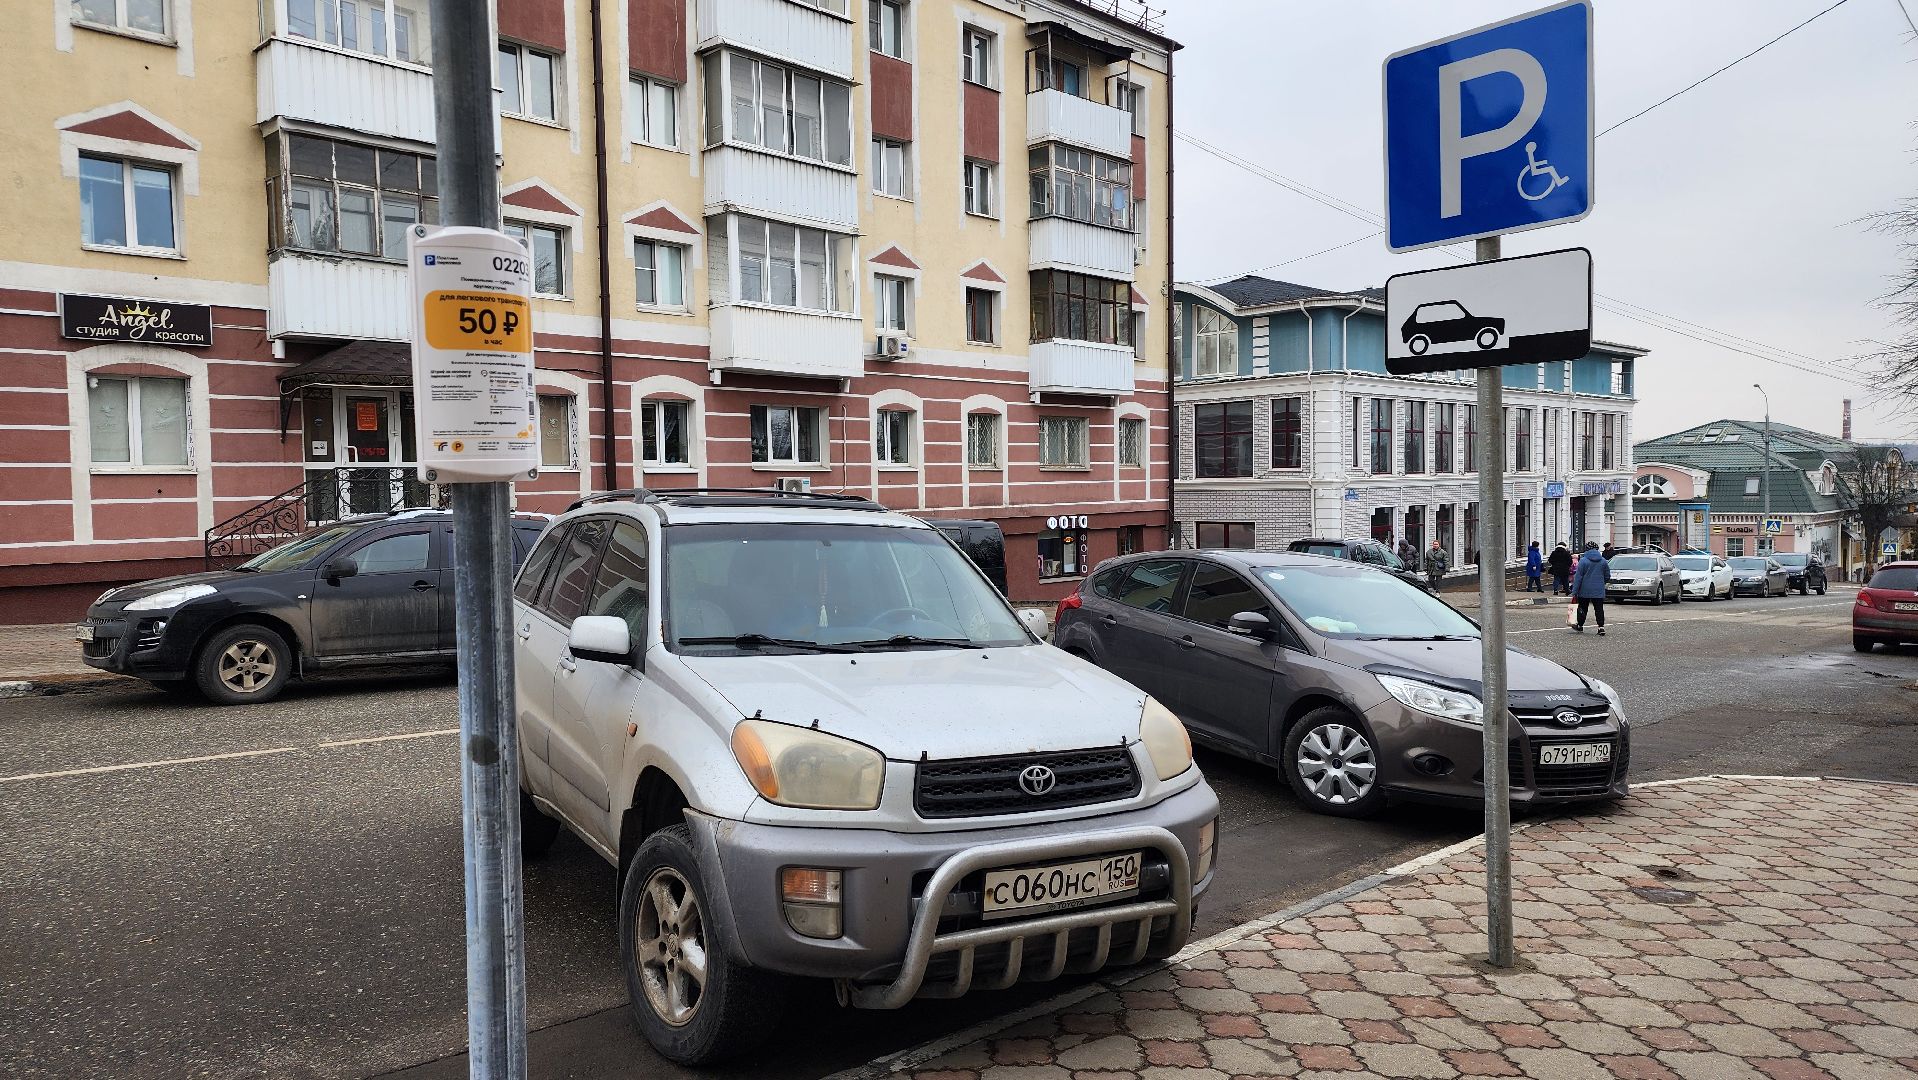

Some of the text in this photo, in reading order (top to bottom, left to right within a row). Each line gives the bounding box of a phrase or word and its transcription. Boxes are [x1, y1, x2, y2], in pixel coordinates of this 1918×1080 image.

[1439, 48, 1548, 219] P
[455, 295, 496, 303] легкового
[99, 304, 174, 339] Angel
[459, 308, 519, 335] 50 ₽
[76, 326, 204, 341] студия красоты
[1047, 515, 1088, 529] ФОТО
[1080, 534, 1088, 573] ФОТО
[1543, 745, 1609, 763] О791РР 790
[993, 855, 1135, 905] С060НС 150
[1108, 879, 1126, 890] RUS
[1057, 899, 1085, 910] TOYOTA
